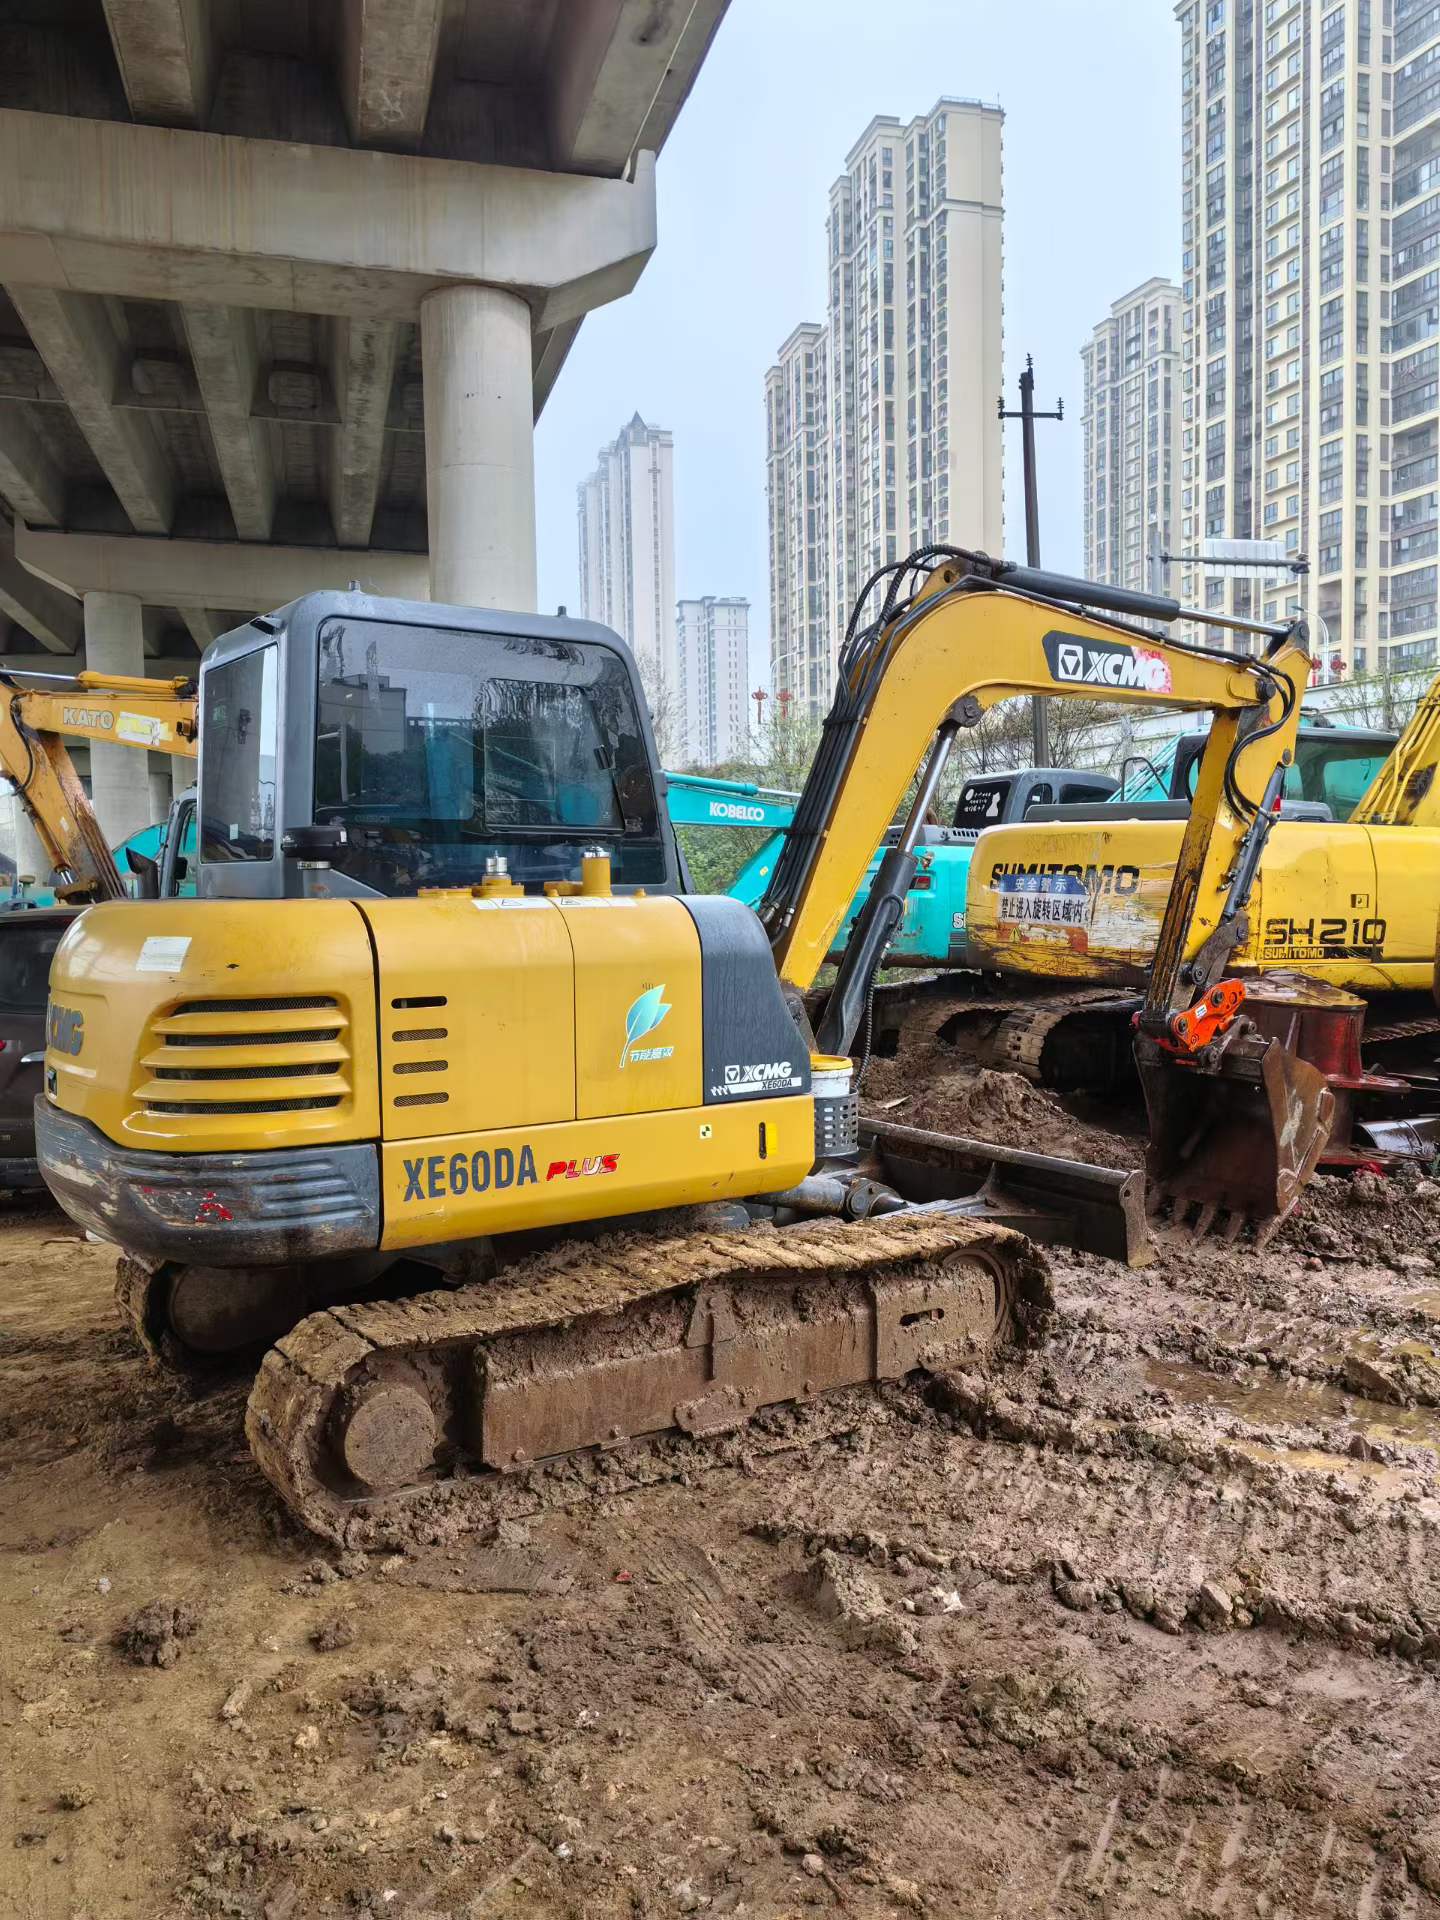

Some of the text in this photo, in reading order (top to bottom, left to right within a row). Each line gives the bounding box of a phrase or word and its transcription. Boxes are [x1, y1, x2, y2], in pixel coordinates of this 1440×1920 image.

[1083, 650, 1166, 689] XCMG
[63, 706, 115, 729] KATO
[709, 801, 765, 821] KOBELCO
[1263, 918, 1387, 945] SH210
[740, 1061, 792, 1082] XCMG
[761, 1078, 793, 1090] XE60DA
[402, 1144, 621, 1202] XE60DA PLUS
